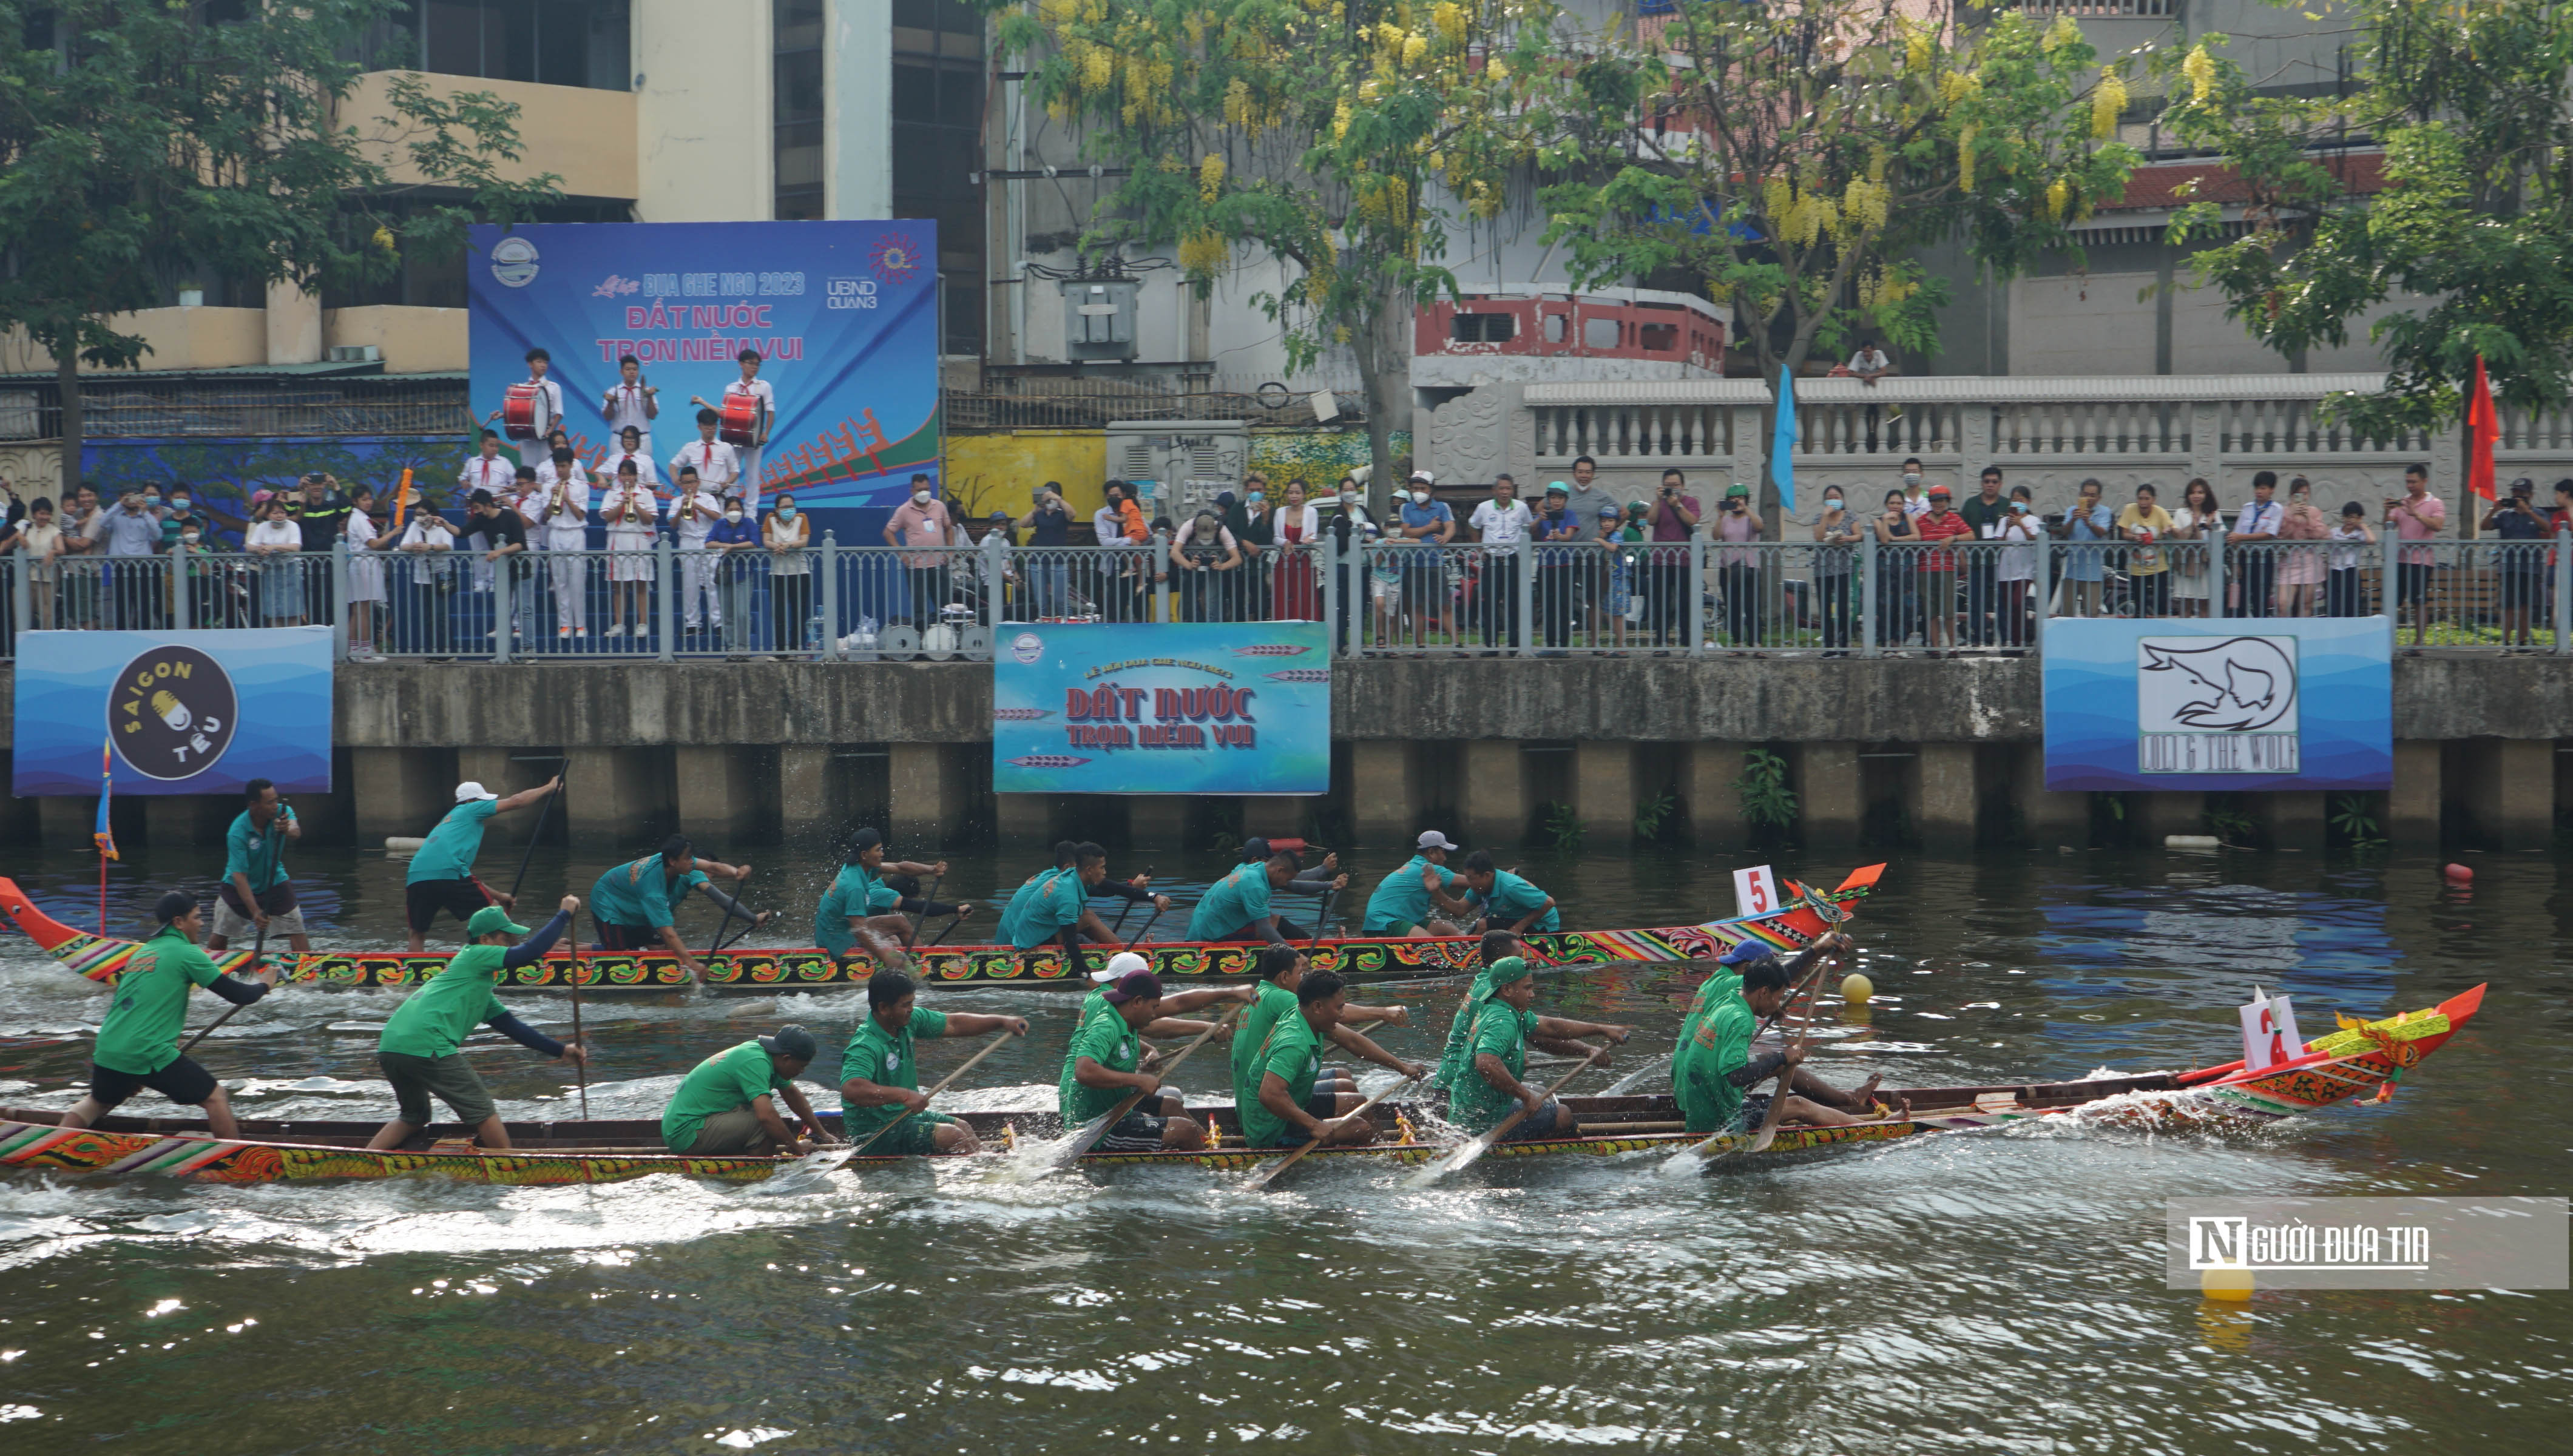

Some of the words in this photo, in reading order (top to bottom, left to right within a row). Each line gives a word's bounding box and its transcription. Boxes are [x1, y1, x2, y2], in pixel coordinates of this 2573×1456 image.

[643, 273, 680, 297] ĐUA
[681, 273, 718, 296] GHE
[720, 272, 756, 296] NGO
[758, 272, 805, 295] 2023
[827, 281, 877, 295] UBND
[626, 297, 689, 329] ĐẤT
[692, 300, 773, 329] NƯỚC
[597, 339, 677, 366] TRỌN
[681, 329, 749, 362] NIỀM
[752, 337, 803, 361] VUI
[123, 661, 194, 733] SAIGON
[1064, 681, 1145, 718] ĐẤT
[1152, 681, 1256, 718] NƯỚC
[1064, 724, 1131, 750] TRỌN
[1137, 720, 1203, 745] NIỀM
[1211, 724, 1253, 745] VUI
[1748, 871, 1768, 914] 5
